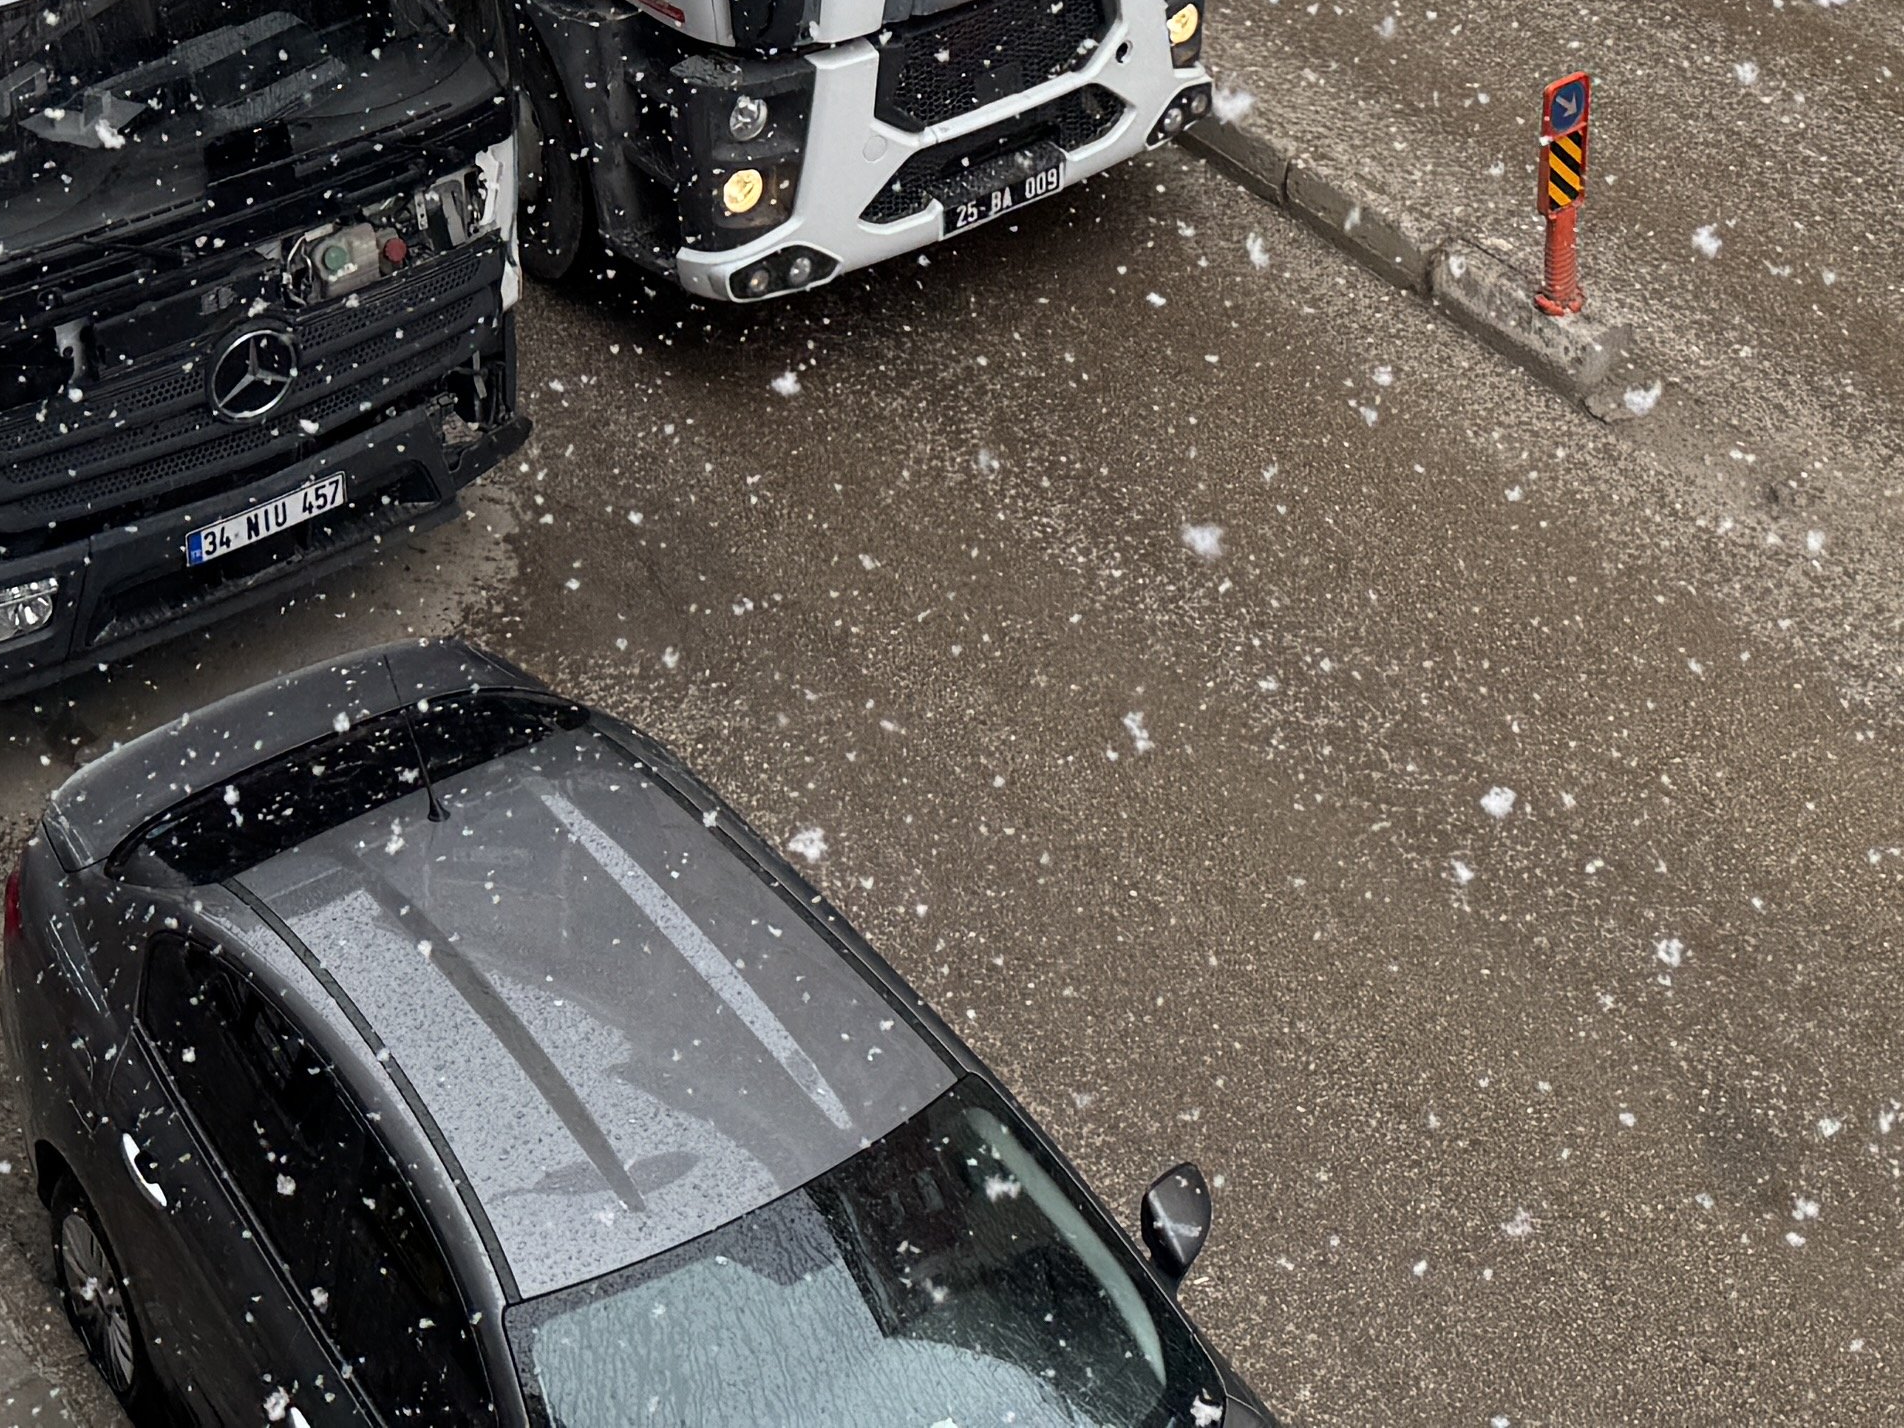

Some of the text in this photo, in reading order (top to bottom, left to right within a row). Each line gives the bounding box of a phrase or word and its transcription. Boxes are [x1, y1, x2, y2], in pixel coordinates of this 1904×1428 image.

[955, 199, 979, 228] 25
[1023, 167, 1059, 200] 009
[203, 478, 341, 556] 34 NIU 457
